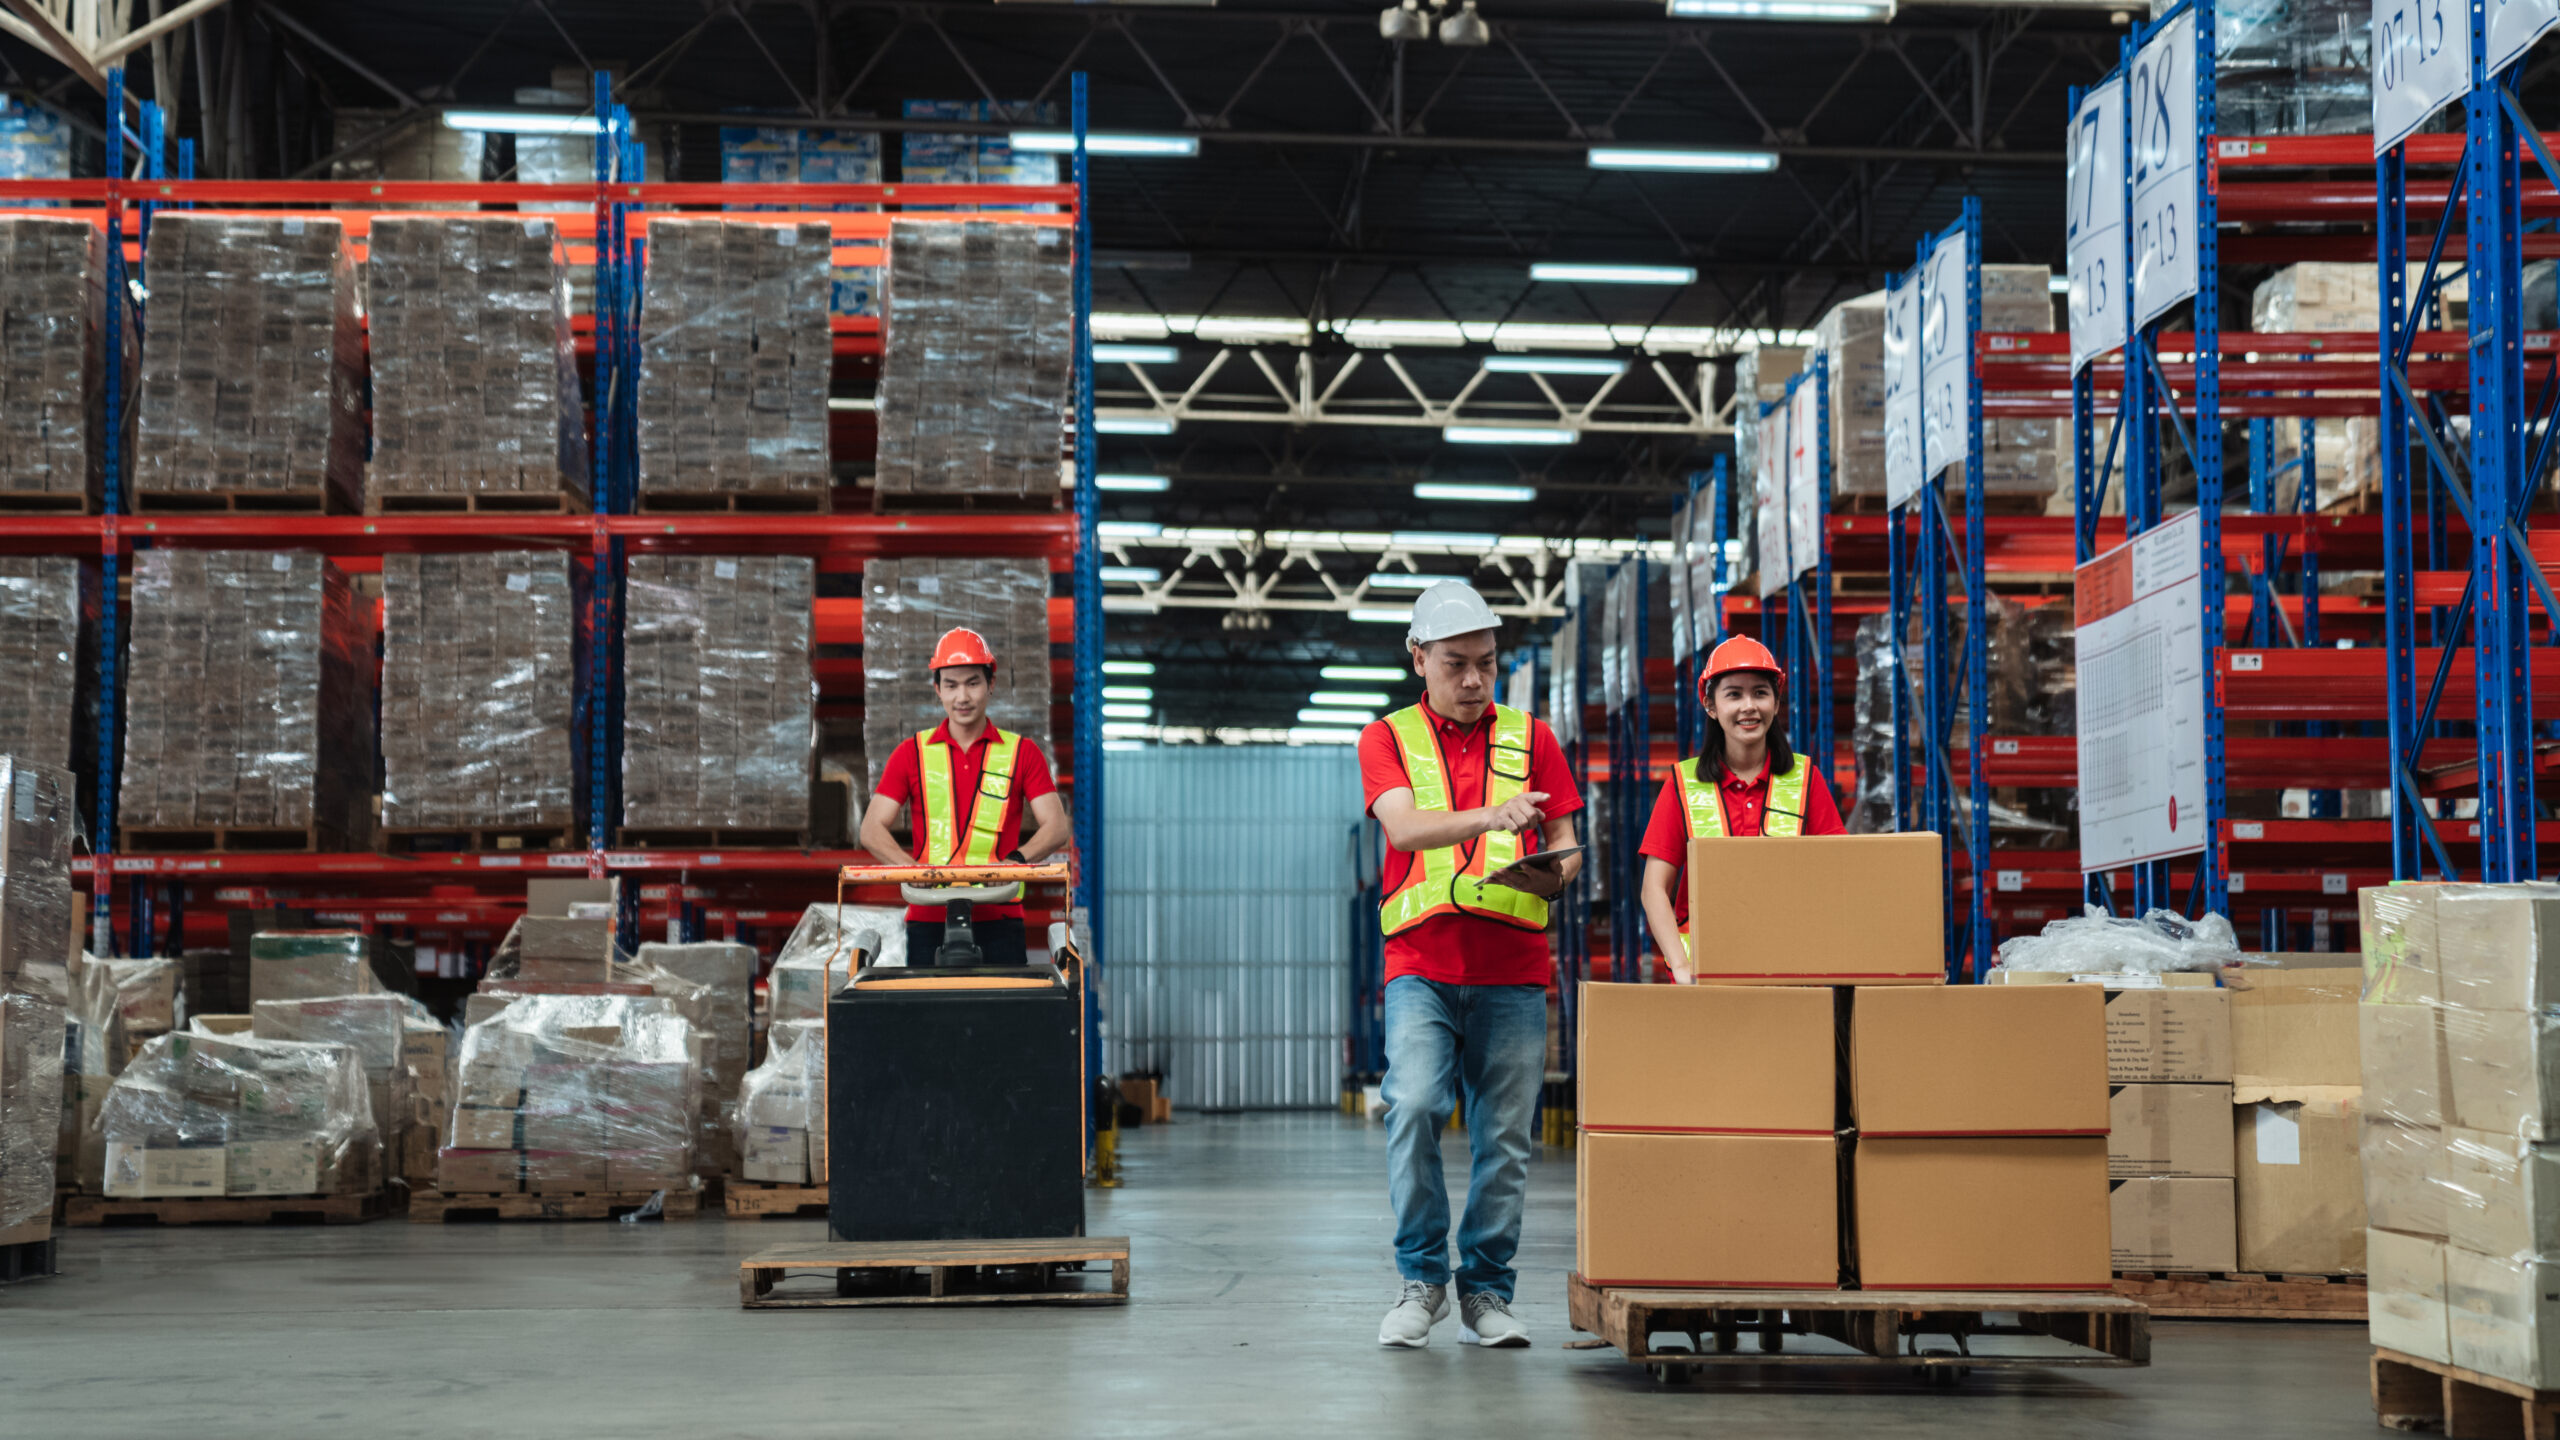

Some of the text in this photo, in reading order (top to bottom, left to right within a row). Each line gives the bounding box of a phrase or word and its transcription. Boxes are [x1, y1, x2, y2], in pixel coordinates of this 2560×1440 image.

[2381, 0, 2443, 91] 07-13
[2067, 105, 2100, 241] 27
[2135, 44, 2173, 187] 28
